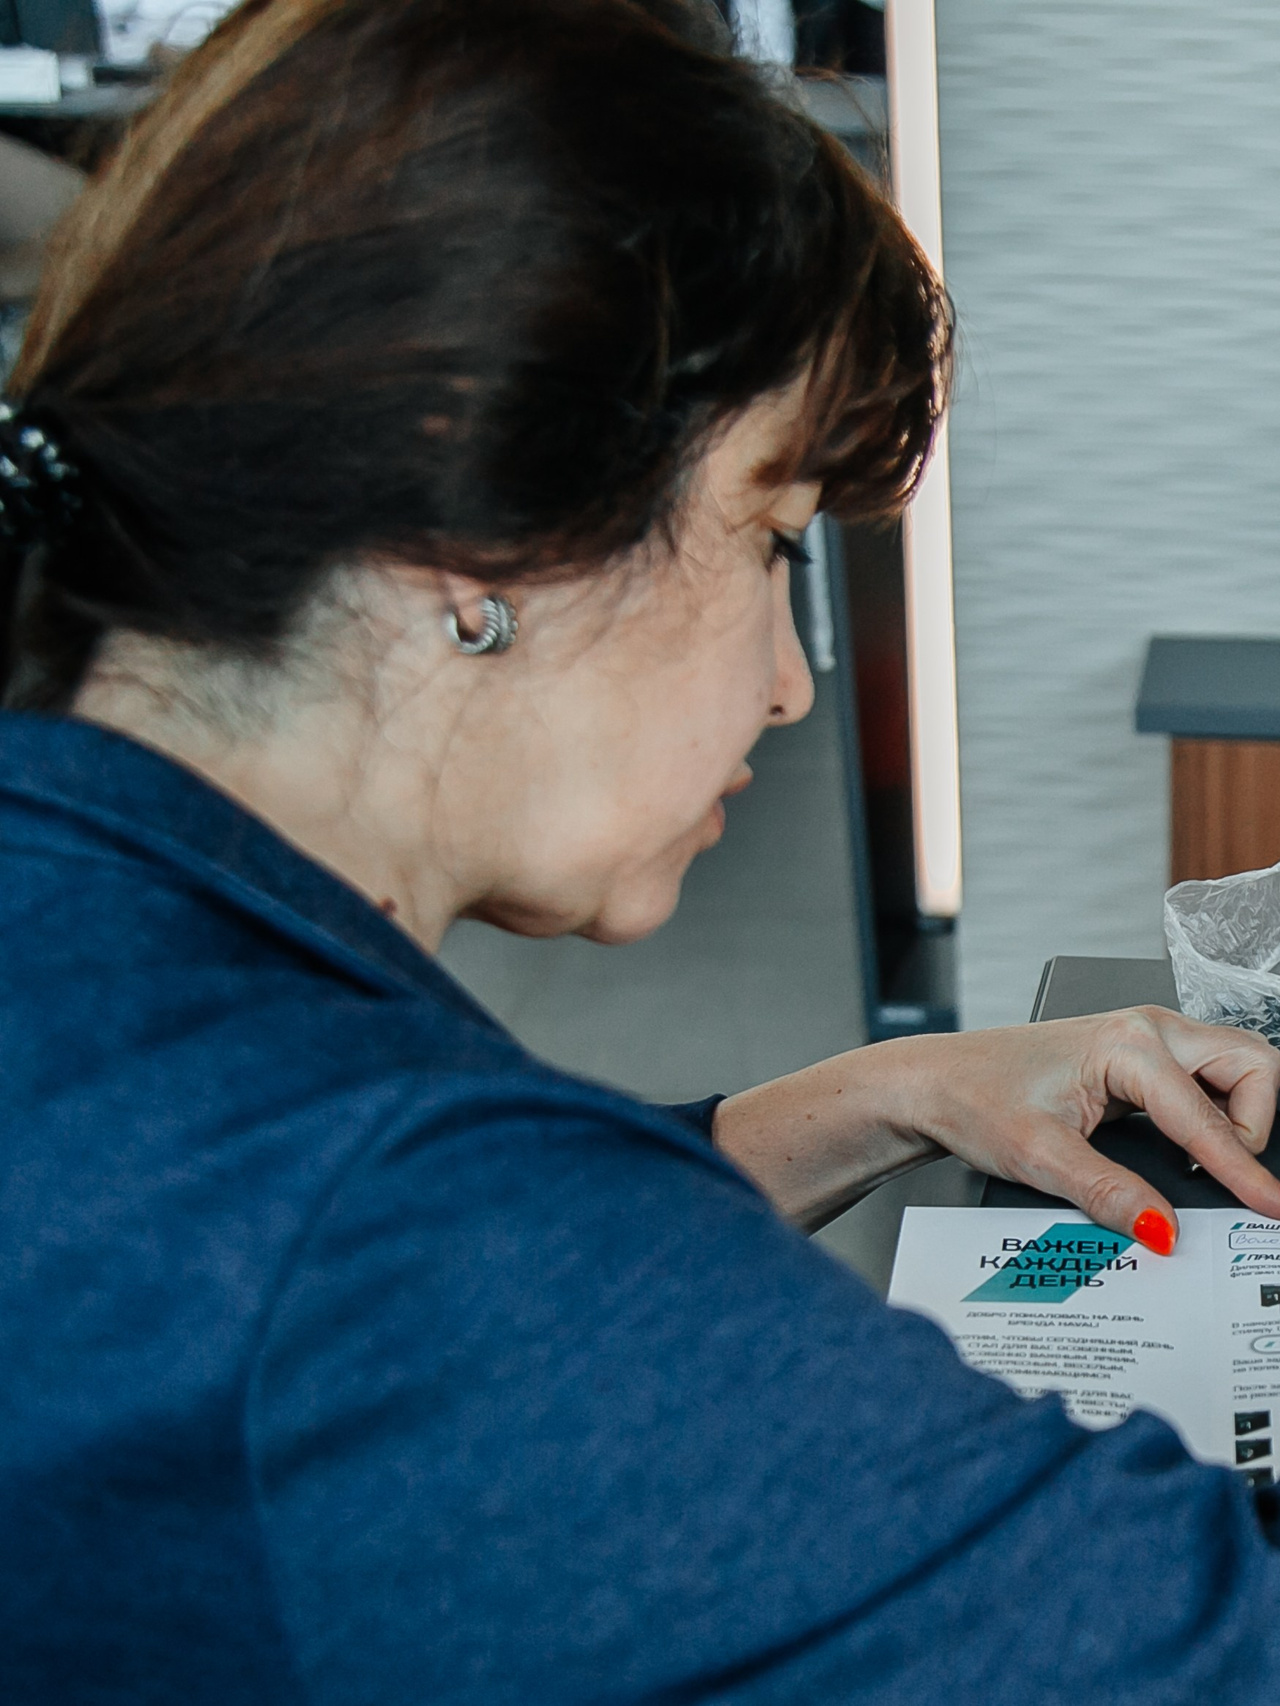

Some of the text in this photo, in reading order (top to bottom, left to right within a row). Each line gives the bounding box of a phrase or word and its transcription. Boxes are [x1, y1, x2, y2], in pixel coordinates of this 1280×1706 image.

[1246, 1222, 1280, 1230] ВАШ
[1002, 1237, 1119, 1255] ВАЖЕН
[980, 1255, 1138, 1273] КАЖДЫЙ
[1009, 1274, 1105, 1289] ДЕНЬ
[1009, 1312, 1090, 1320] ПОЖАЛОВАТЬ
[1111, 1314, 1145, 1323] ДЕНЬ
[1141, 1341, 1175, 1350] ДЕНЬ
